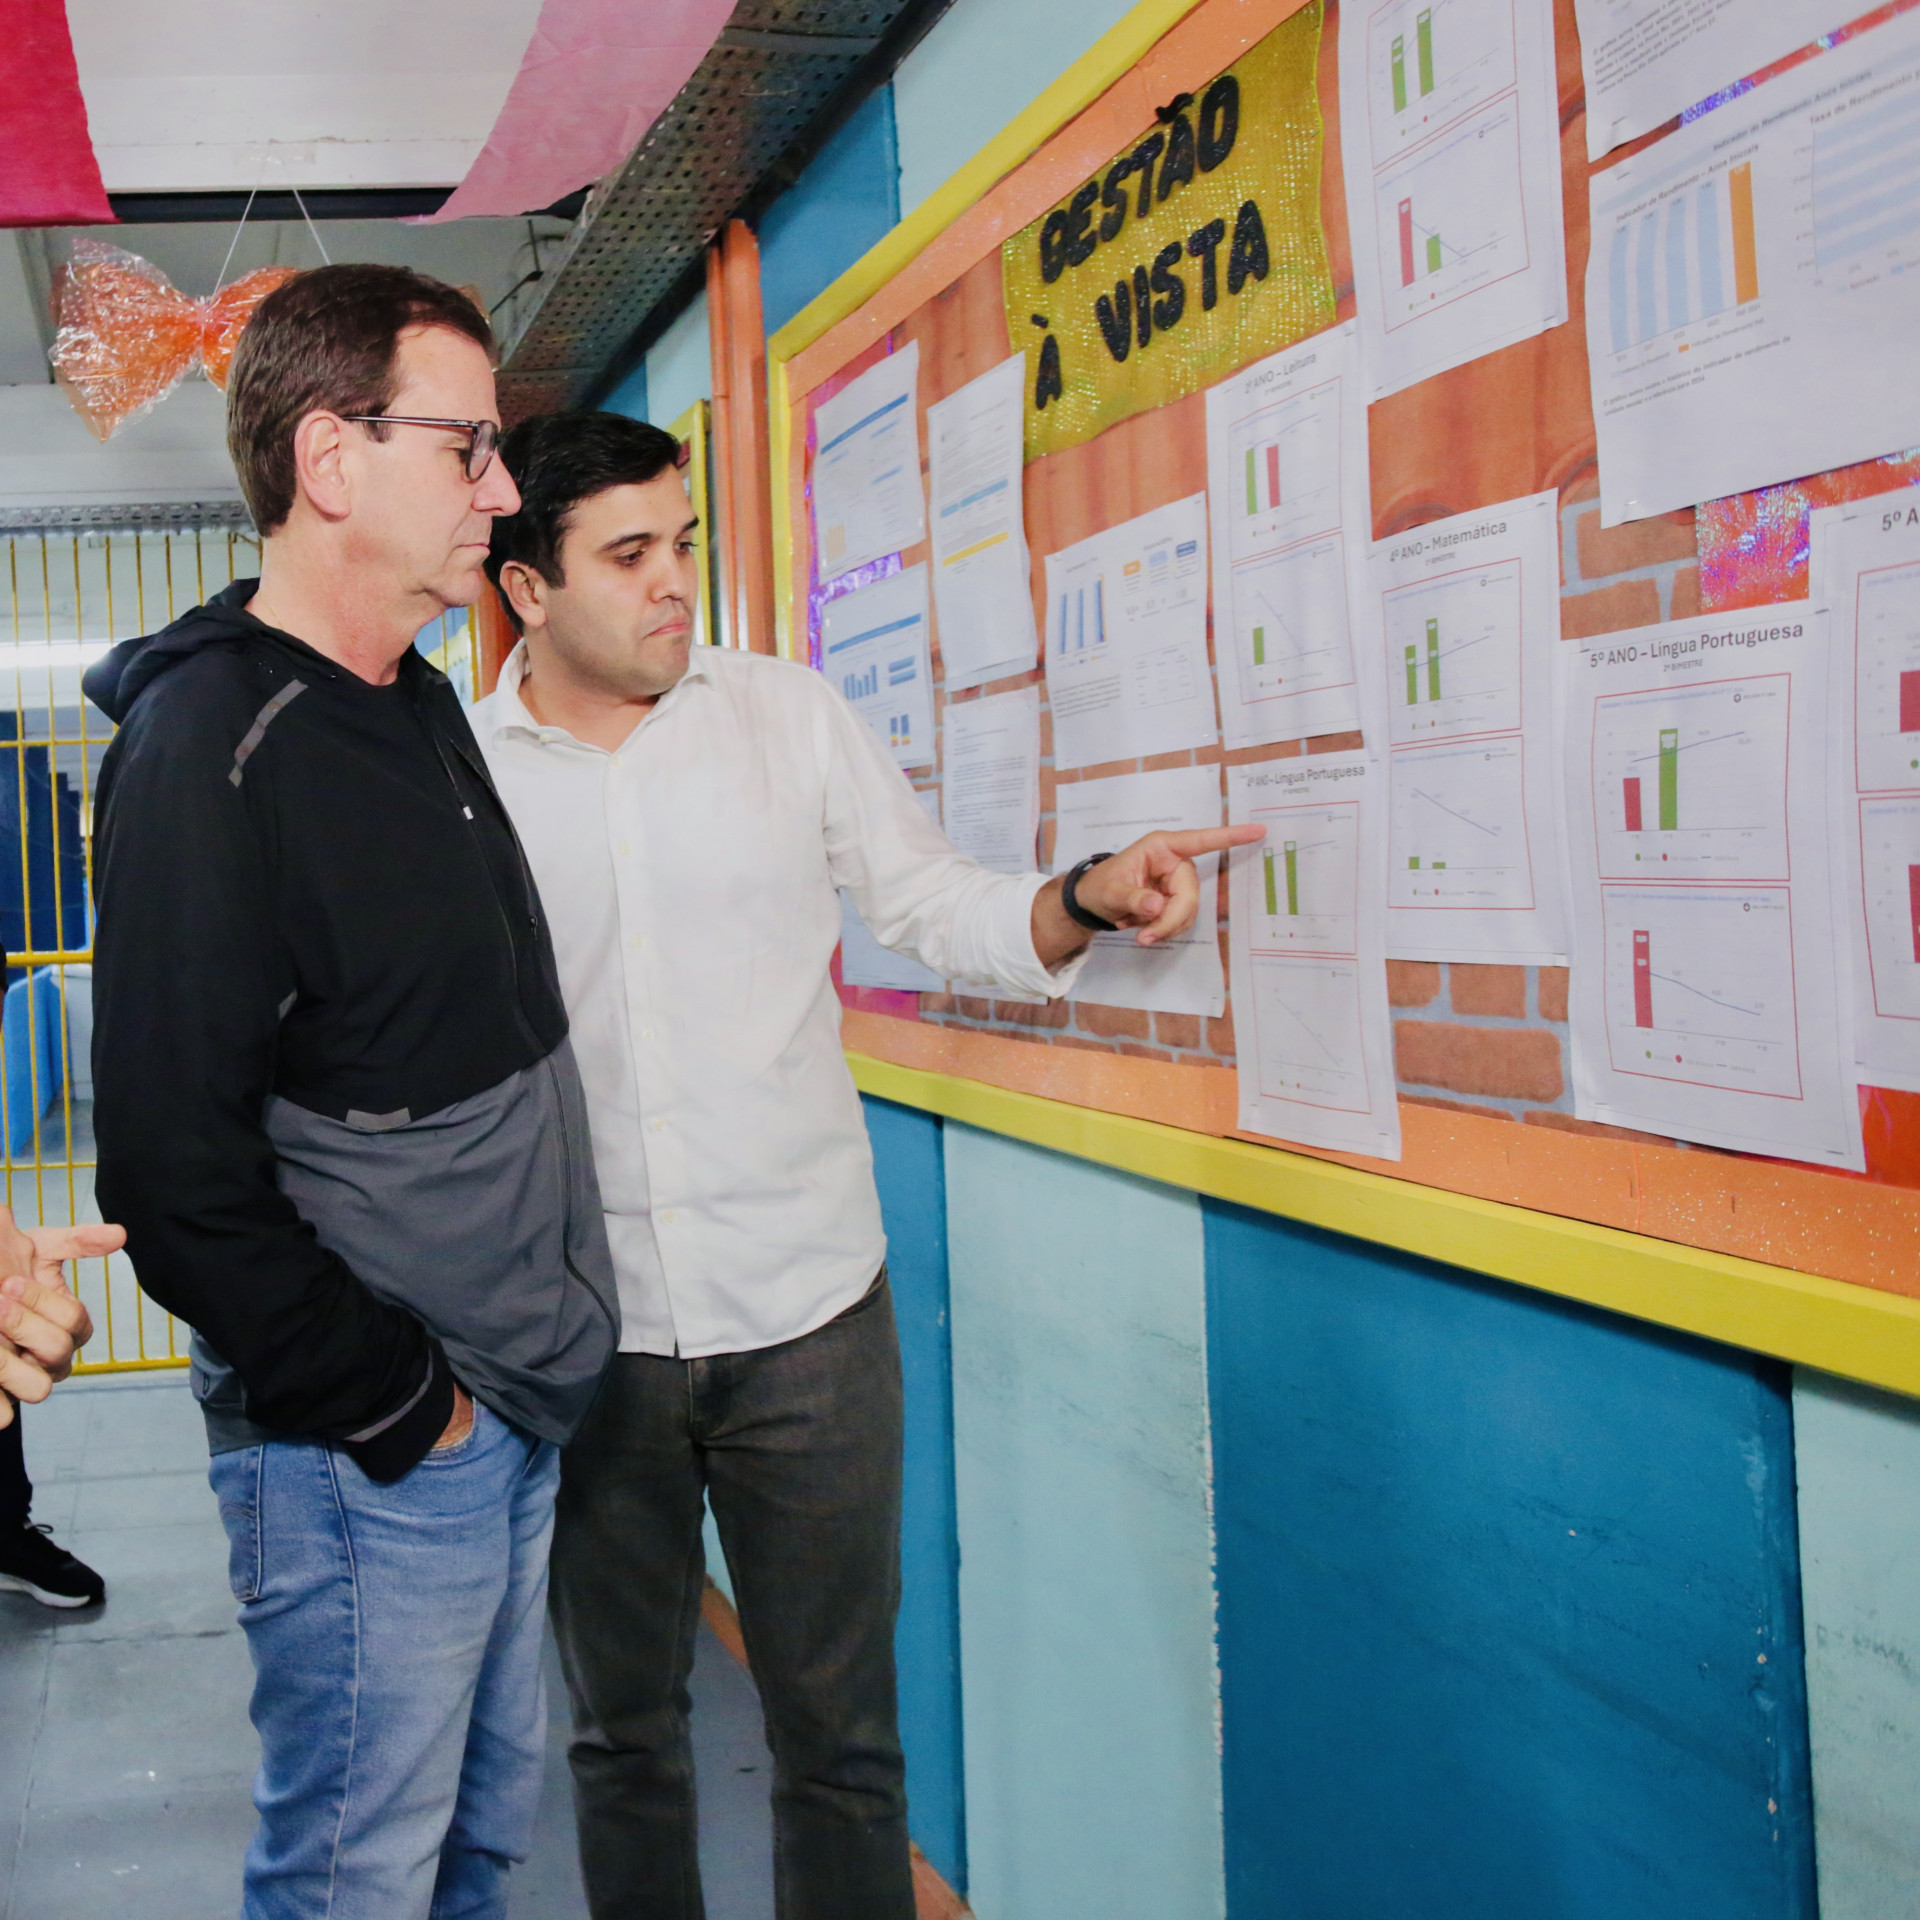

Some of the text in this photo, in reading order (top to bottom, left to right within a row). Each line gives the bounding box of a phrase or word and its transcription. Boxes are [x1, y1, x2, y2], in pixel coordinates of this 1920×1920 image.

[1810, 111, 1832, 125] Taxa
[1097, 199, 1270, 363] VISTA
[1253, 370, 1274, 390] ANO
[1283, 353, 1316, 376] Leitura
[1882, 510, 1901, 532] 5º
[1401, 541, 1423, 560] ANO
[1432, 521, 1507, 550] Matemática
[1590, 651, 1605, 668] 5º
[1607, 646, 1637, 666] ANO
[1700, 624, 1804, 650] Portuguesa
[1306, 766, 1366, 782] Portuguesa
